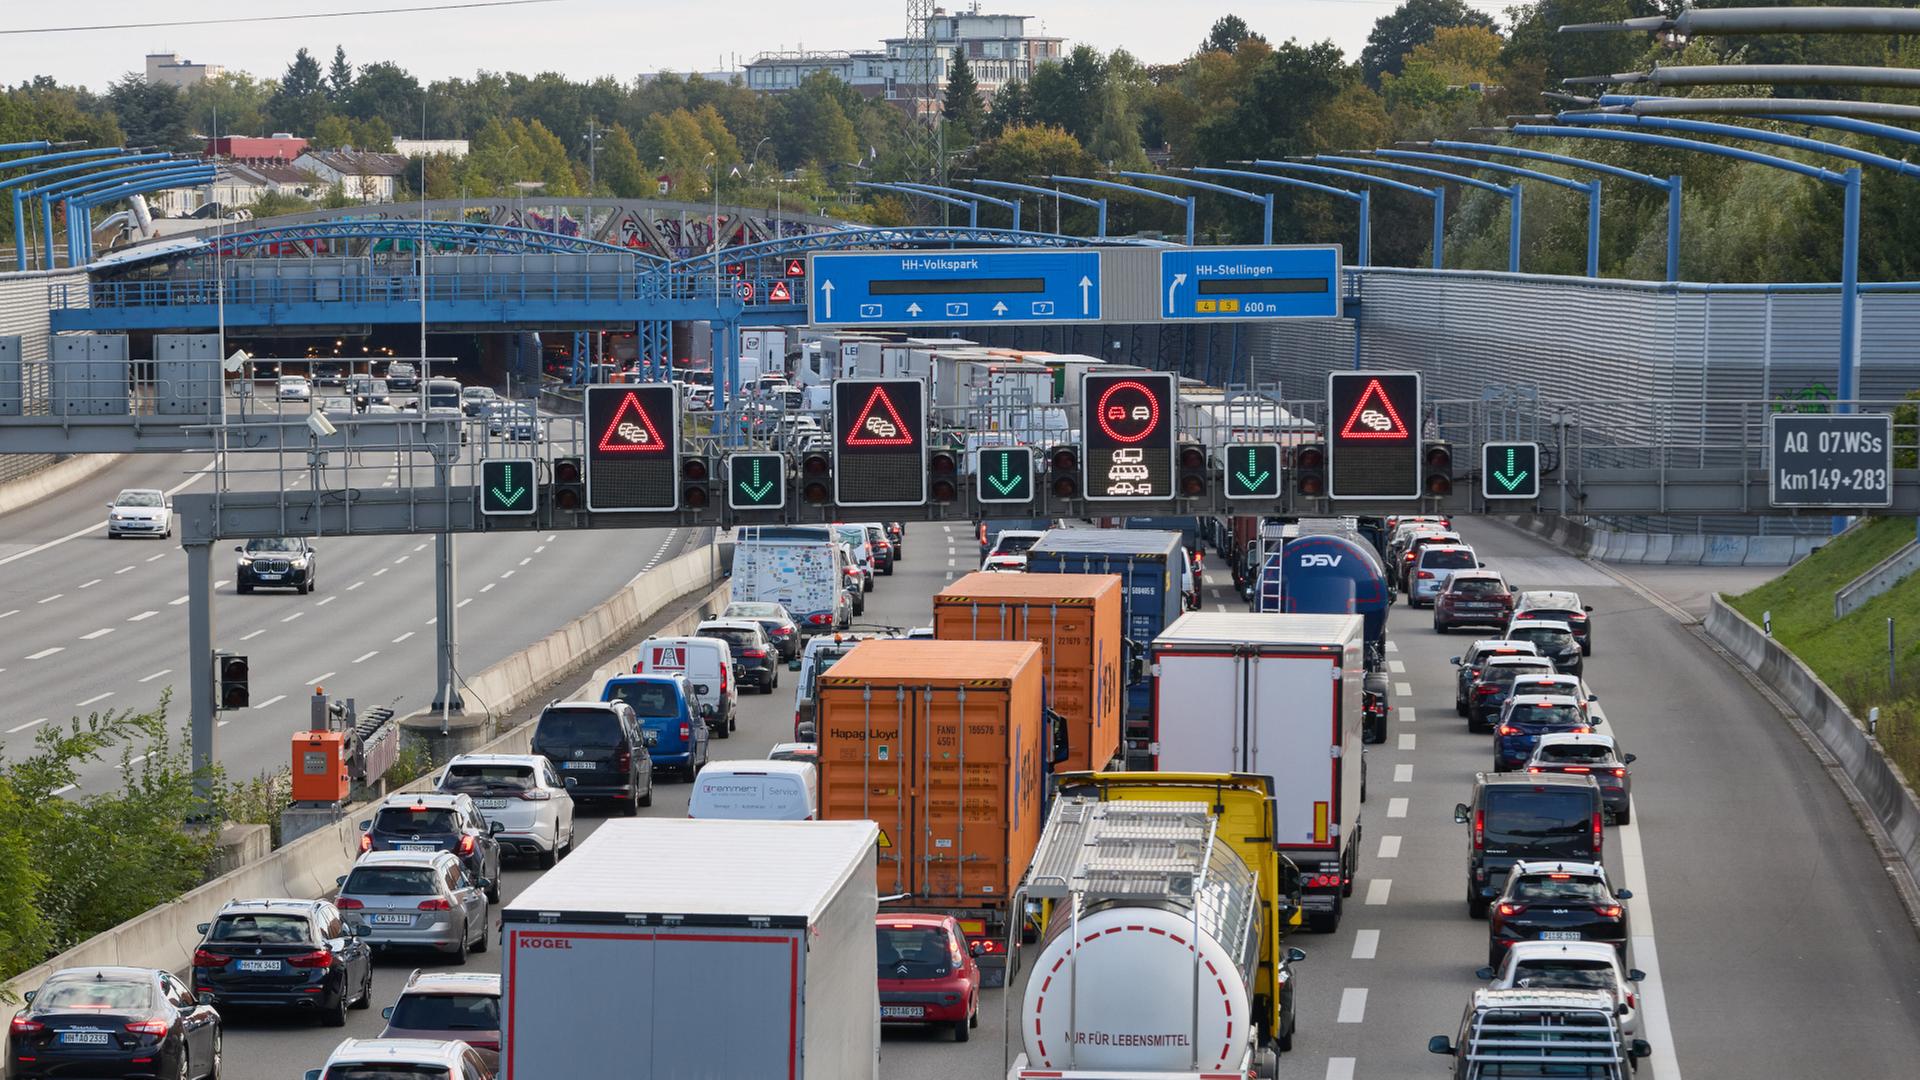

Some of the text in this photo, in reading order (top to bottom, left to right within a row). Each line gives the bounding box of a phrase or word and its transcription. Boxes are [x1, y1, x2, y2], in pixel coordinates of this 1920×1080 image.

[901, 258, 979, 272] HH-Volkspark
[1196, 264, 1273, 277] HH-Stellingen
[1244, 302, 1264, 312] 600
[1266, 304, 1277, 312] m
[1784, 431, 1882, 453] AQ 07.WSs
[1301, 554, 1342, 567] DSV
[768, 786, 799, 796] Service
[520, 937, 573, 949] KÖGEL
[1088, 1031, 1110, 1046] FÜR
[1112, 1034, 1190, 1047] LEBENSMITTEL
